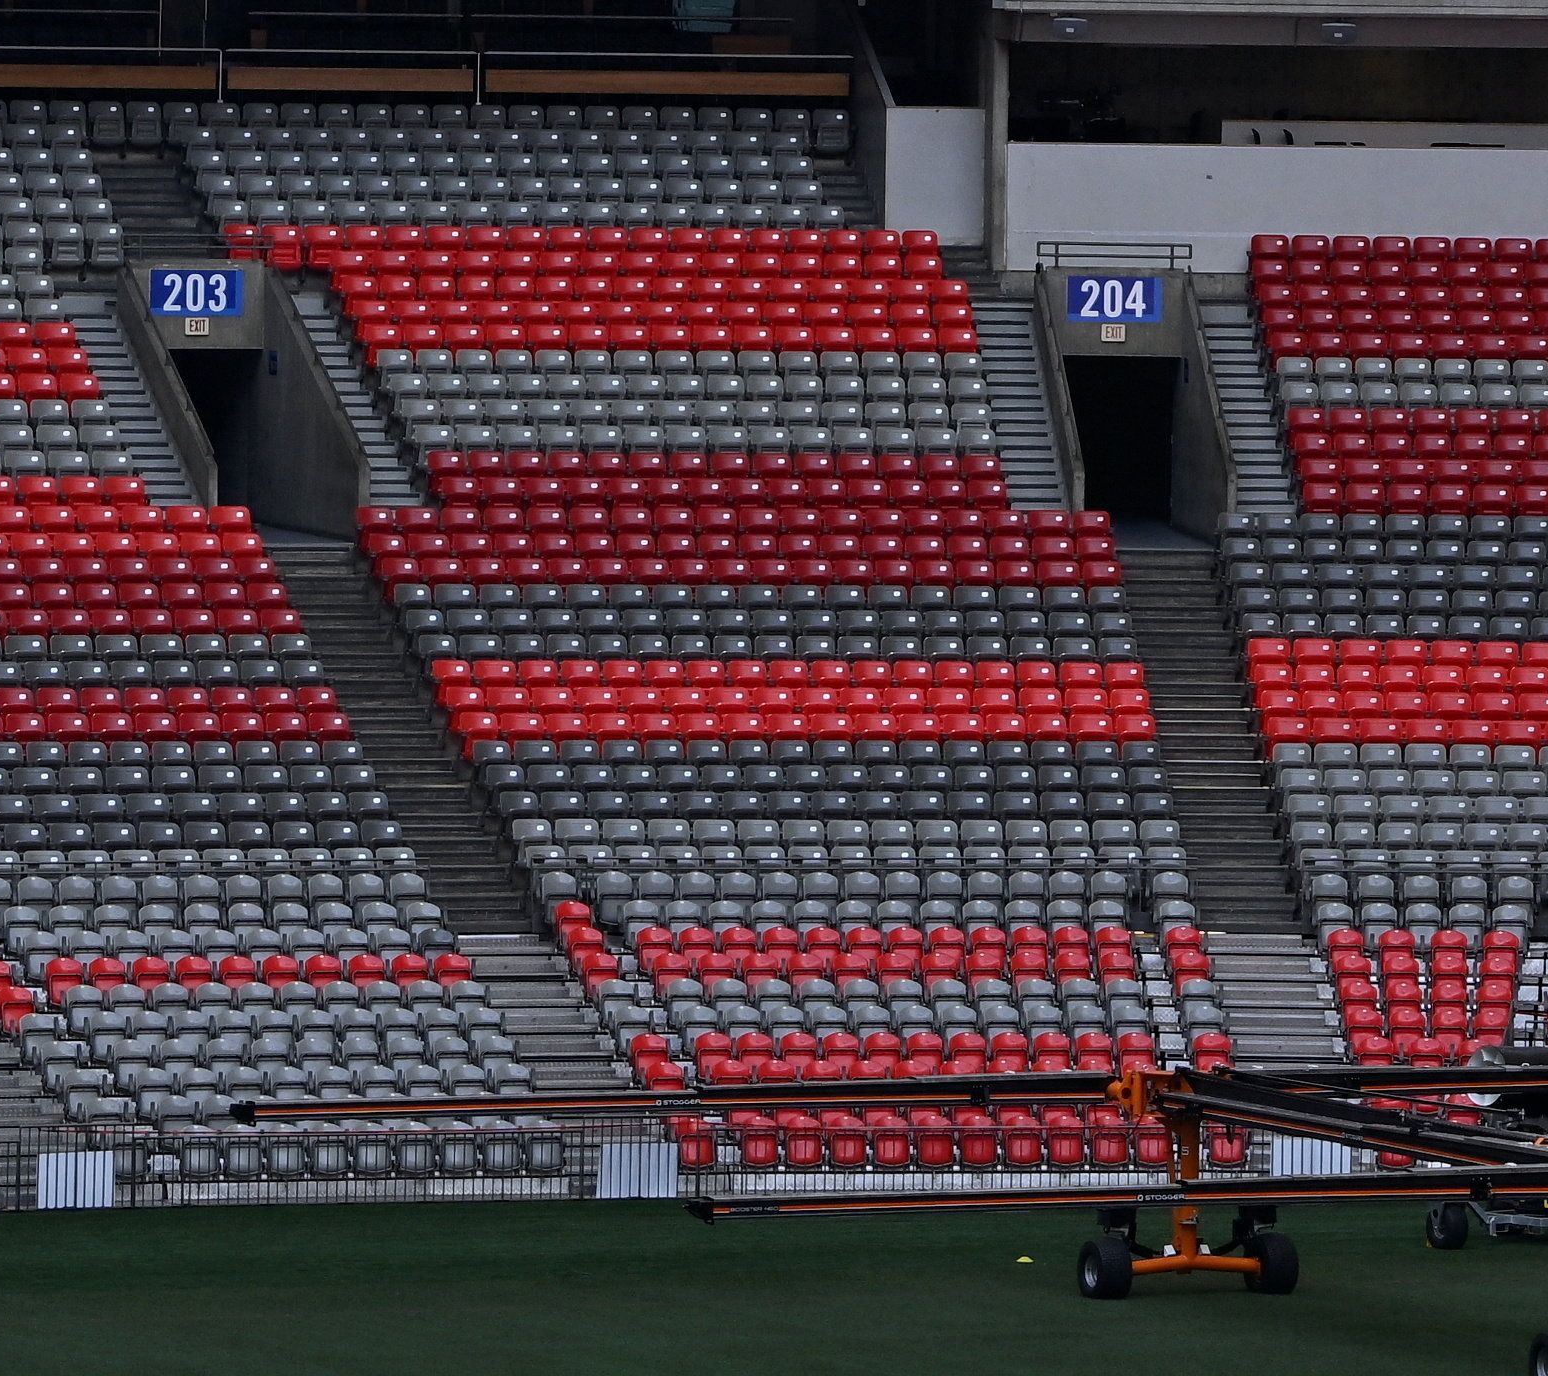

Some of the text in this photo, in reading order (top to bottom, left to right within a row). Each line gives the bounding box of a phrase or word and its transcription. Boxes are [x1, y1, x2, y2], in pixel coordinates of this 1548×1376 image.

[164, 274, 226, 311] 203
[1081, 280, 1145, 317] 204
[188, 319, 207, 333] EXIT
[1104, 326, 1123, 339] EXIT
[663, 1098, 701, 1106] STOGGER
[1145, 1193, 1186, 1201] STOGGER
